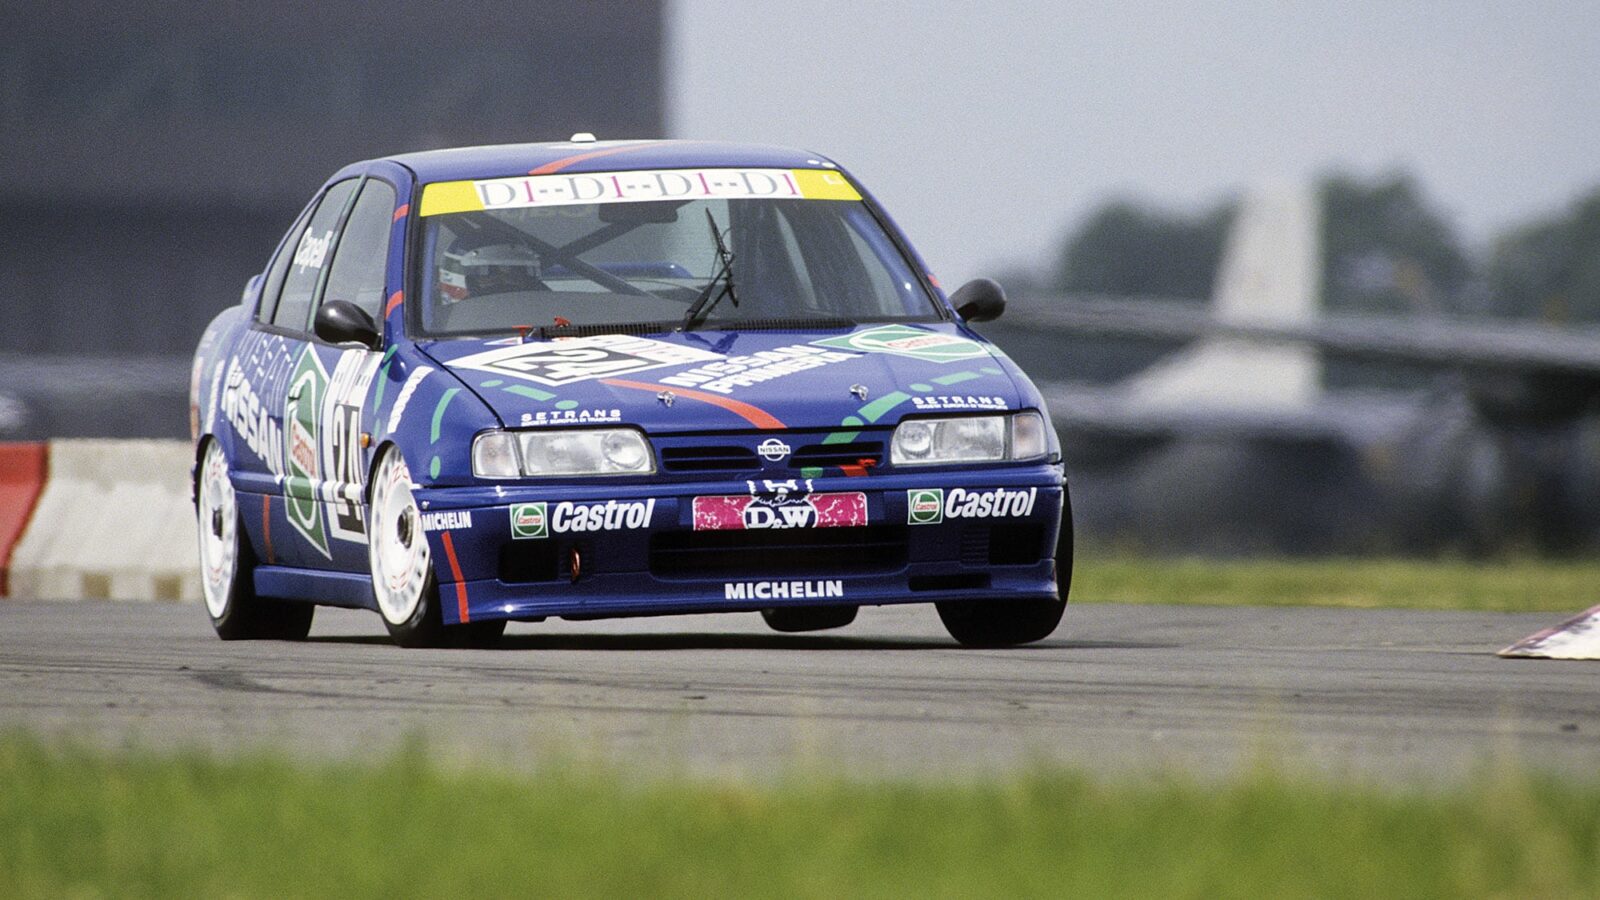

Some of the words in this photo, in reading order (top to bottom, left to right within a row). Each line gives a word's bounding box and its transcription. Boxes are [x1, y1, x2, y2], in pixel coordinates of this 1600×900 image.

[659, 345, 827, 387] NISSAN
[700, 352, 864, 394] PRIMERA
[521, 409, 621, 422] SETRANS
[911, 396, 1006, 405] SETRANS
[220, 355, 285, 485] NISSAN
[552, 498, 655, 533] Castrol
[945, 487, 1037, 518] Castrol
[421, 511, 472, 531] MICHELIN
[725, 580, 843, 600] MICHELIN
